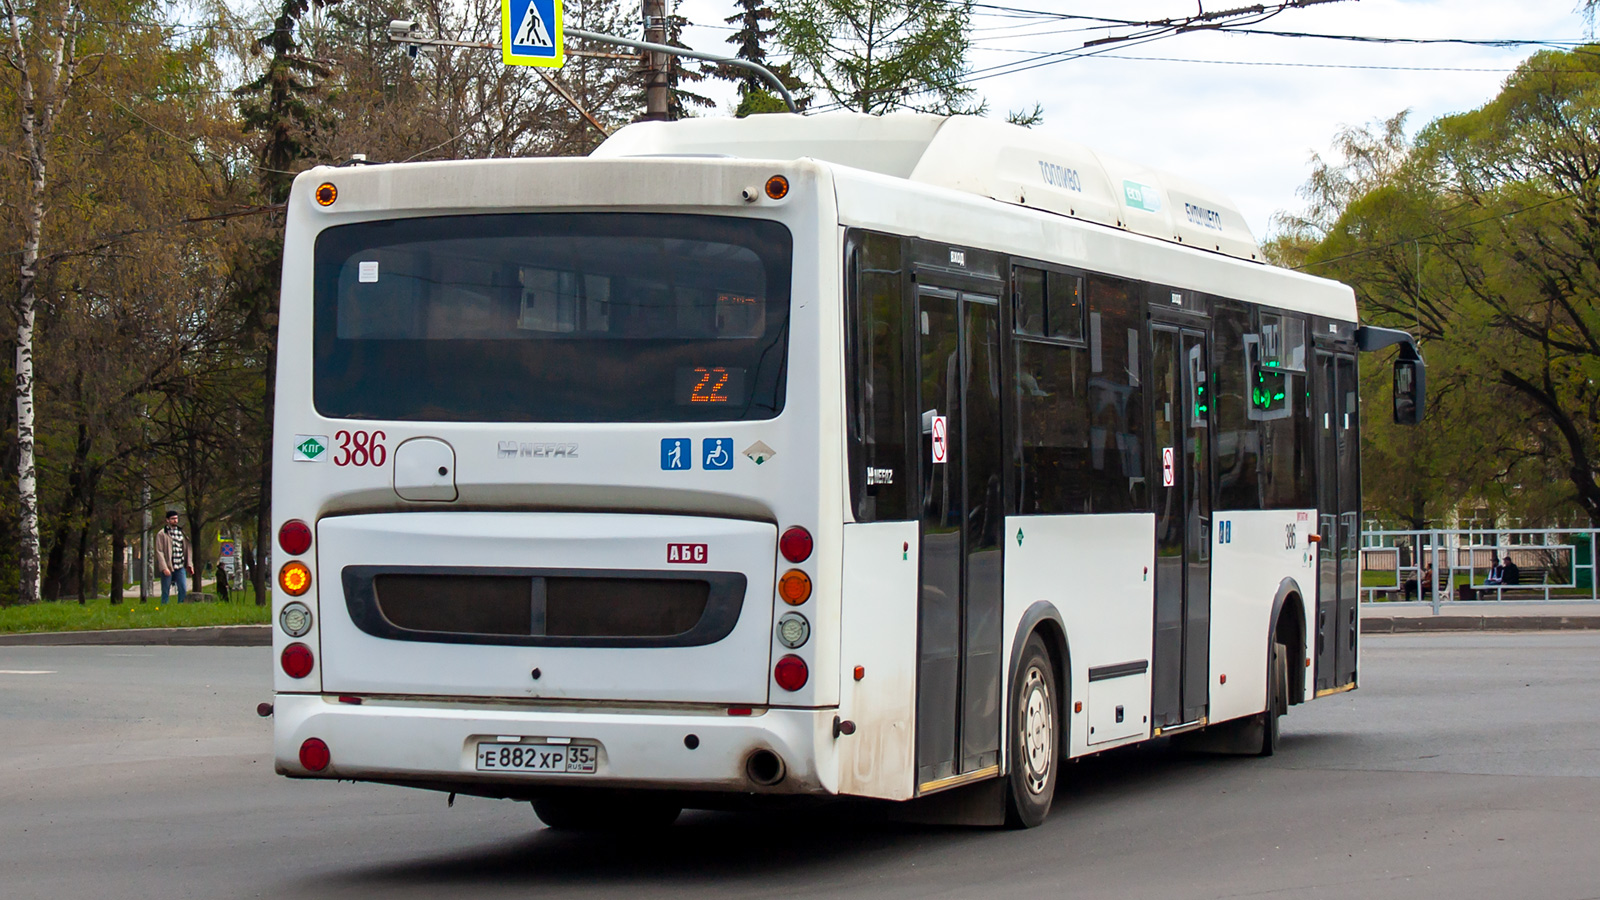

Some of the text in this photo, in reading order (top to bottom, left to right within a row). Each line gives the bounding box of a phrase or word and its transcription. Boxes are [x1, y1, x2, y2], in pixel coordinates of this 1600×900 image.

[1038, 160, 1081, 192] ТОПЛИВО
[691, 367, 728, 402] 22
[302, 444, 320, 453] КПГ
[333, 430, 386, 467] 386
[520, 442, 579, 458] NEFAZ
[669, 545, 704, 561] АБС
[569, 748, 589, 763] 35
